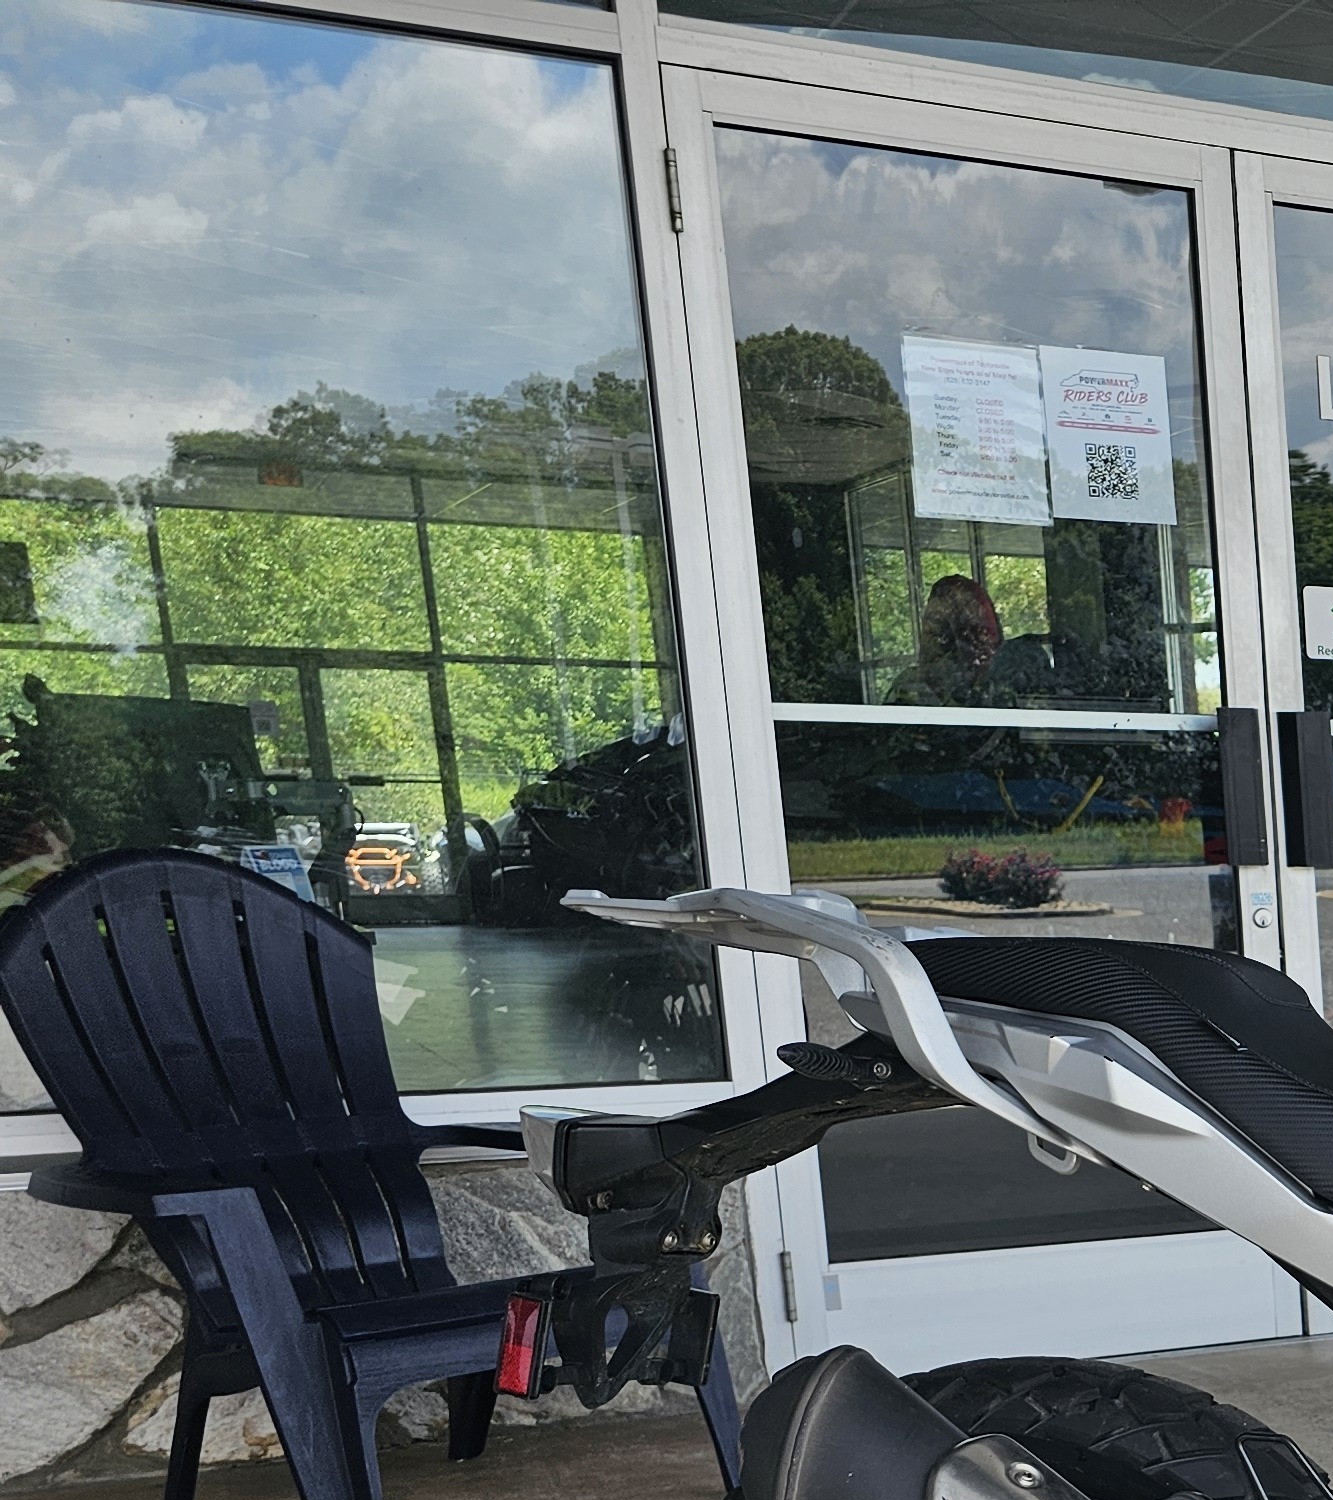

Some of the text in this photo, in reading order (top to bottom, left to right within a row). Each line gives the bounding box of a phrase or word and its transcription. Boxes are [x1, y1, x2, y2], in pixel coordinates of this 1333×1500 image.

[1063, 389, 1149, 404] RIDERS CLUB
[934, 403, 960, 412] Monday
[935, 413, 961, 422] Tuesday
